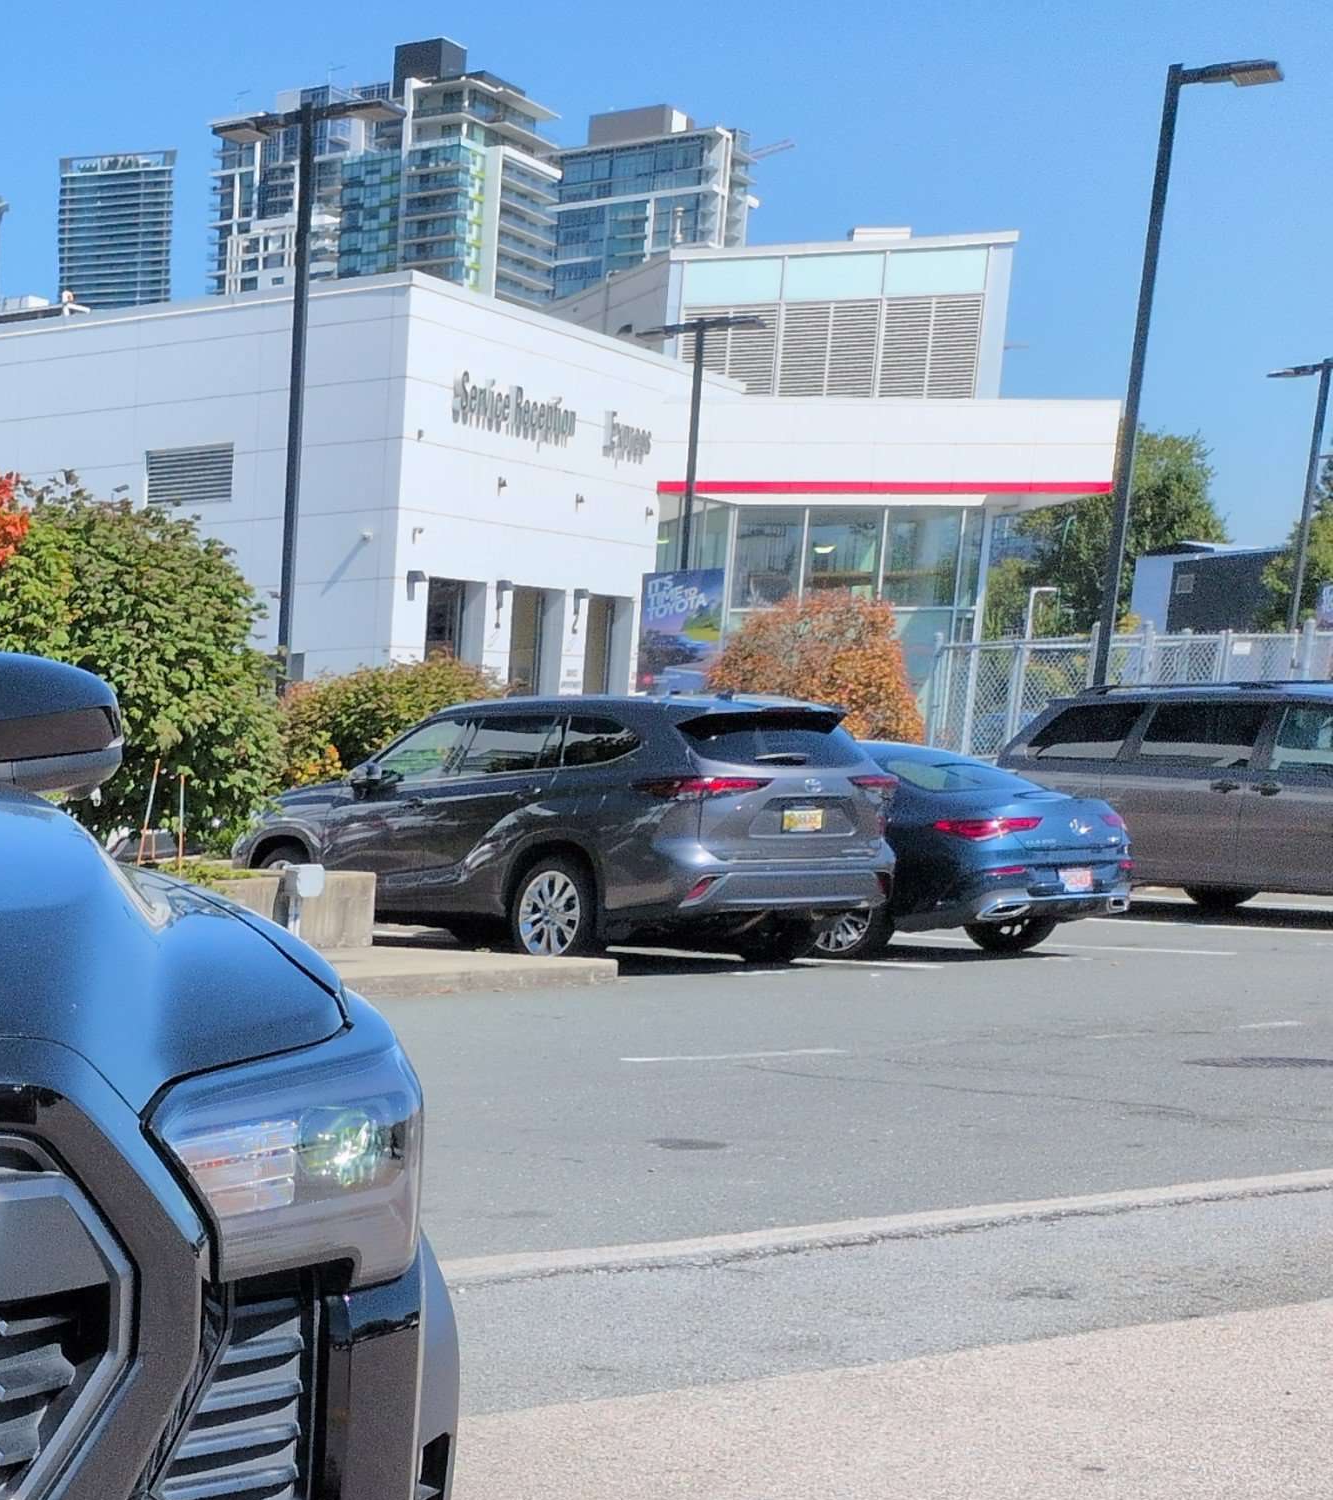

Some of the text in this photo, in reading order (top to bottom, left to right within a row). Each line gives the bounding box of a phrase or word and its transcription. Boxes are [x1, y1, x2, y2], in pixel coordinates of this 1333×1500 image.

[459, 370, 577, 440] Service Reception
[648, 575, 674, 594] IT'S
[648, 585, 685, 608] TIME
[647, 592, 709, 621] TOYOTA
